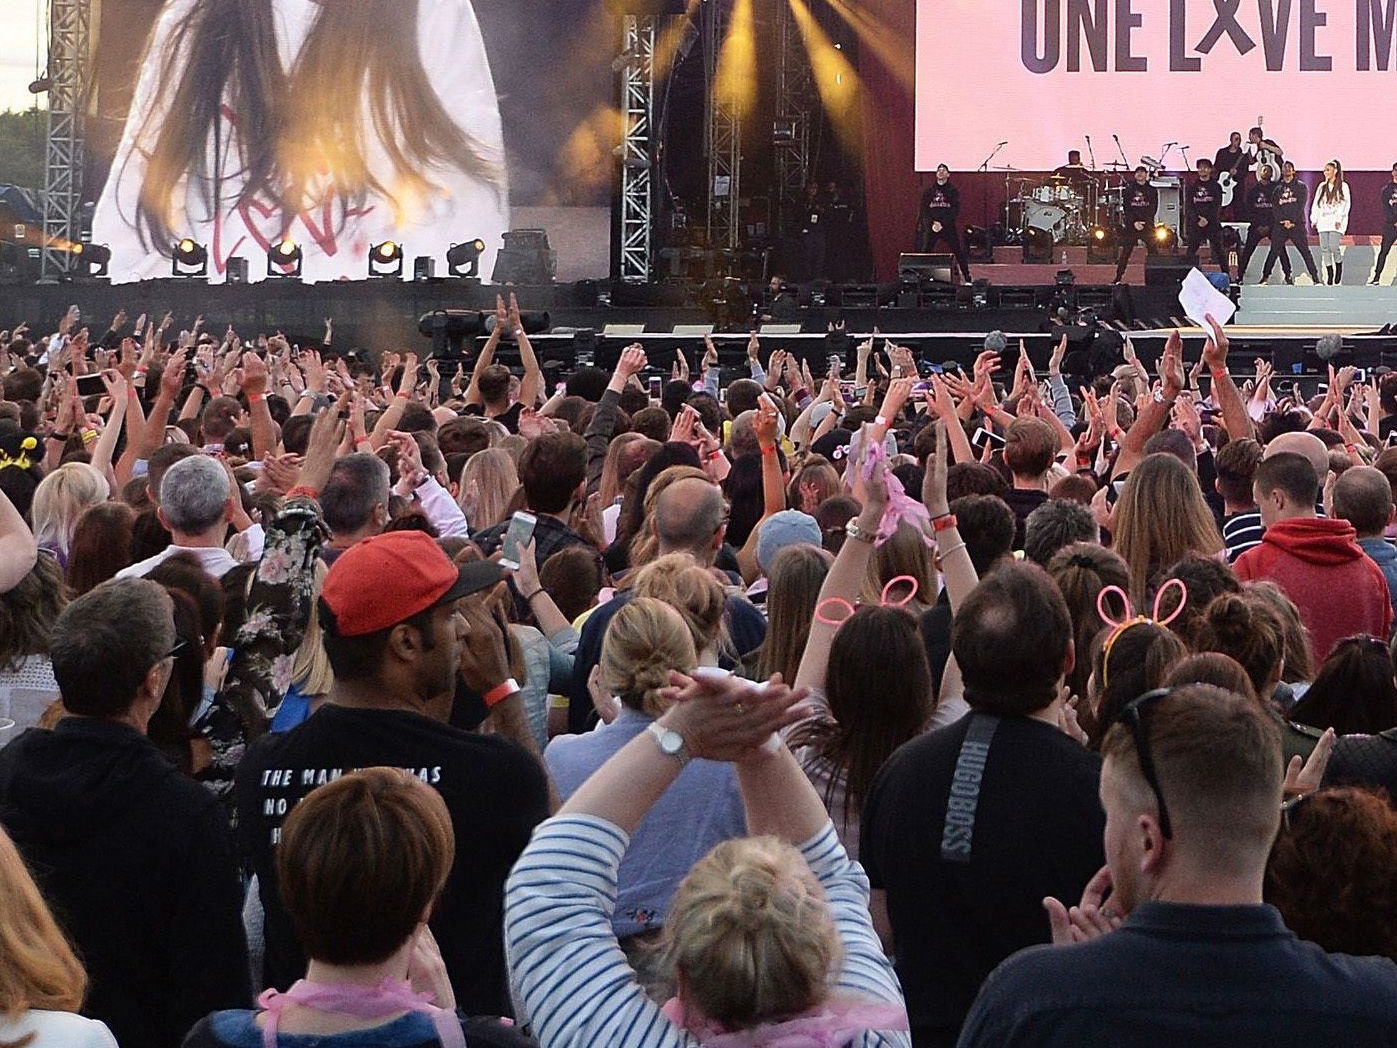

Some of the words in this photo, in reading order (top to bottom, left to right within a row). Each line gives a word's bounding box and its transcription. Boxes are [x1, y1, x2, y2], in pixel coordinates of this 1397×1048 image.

[262, 769, 293, 786] THE
[303, 768, 343, 785] MAN
[264, 798, 287, 815] NO
